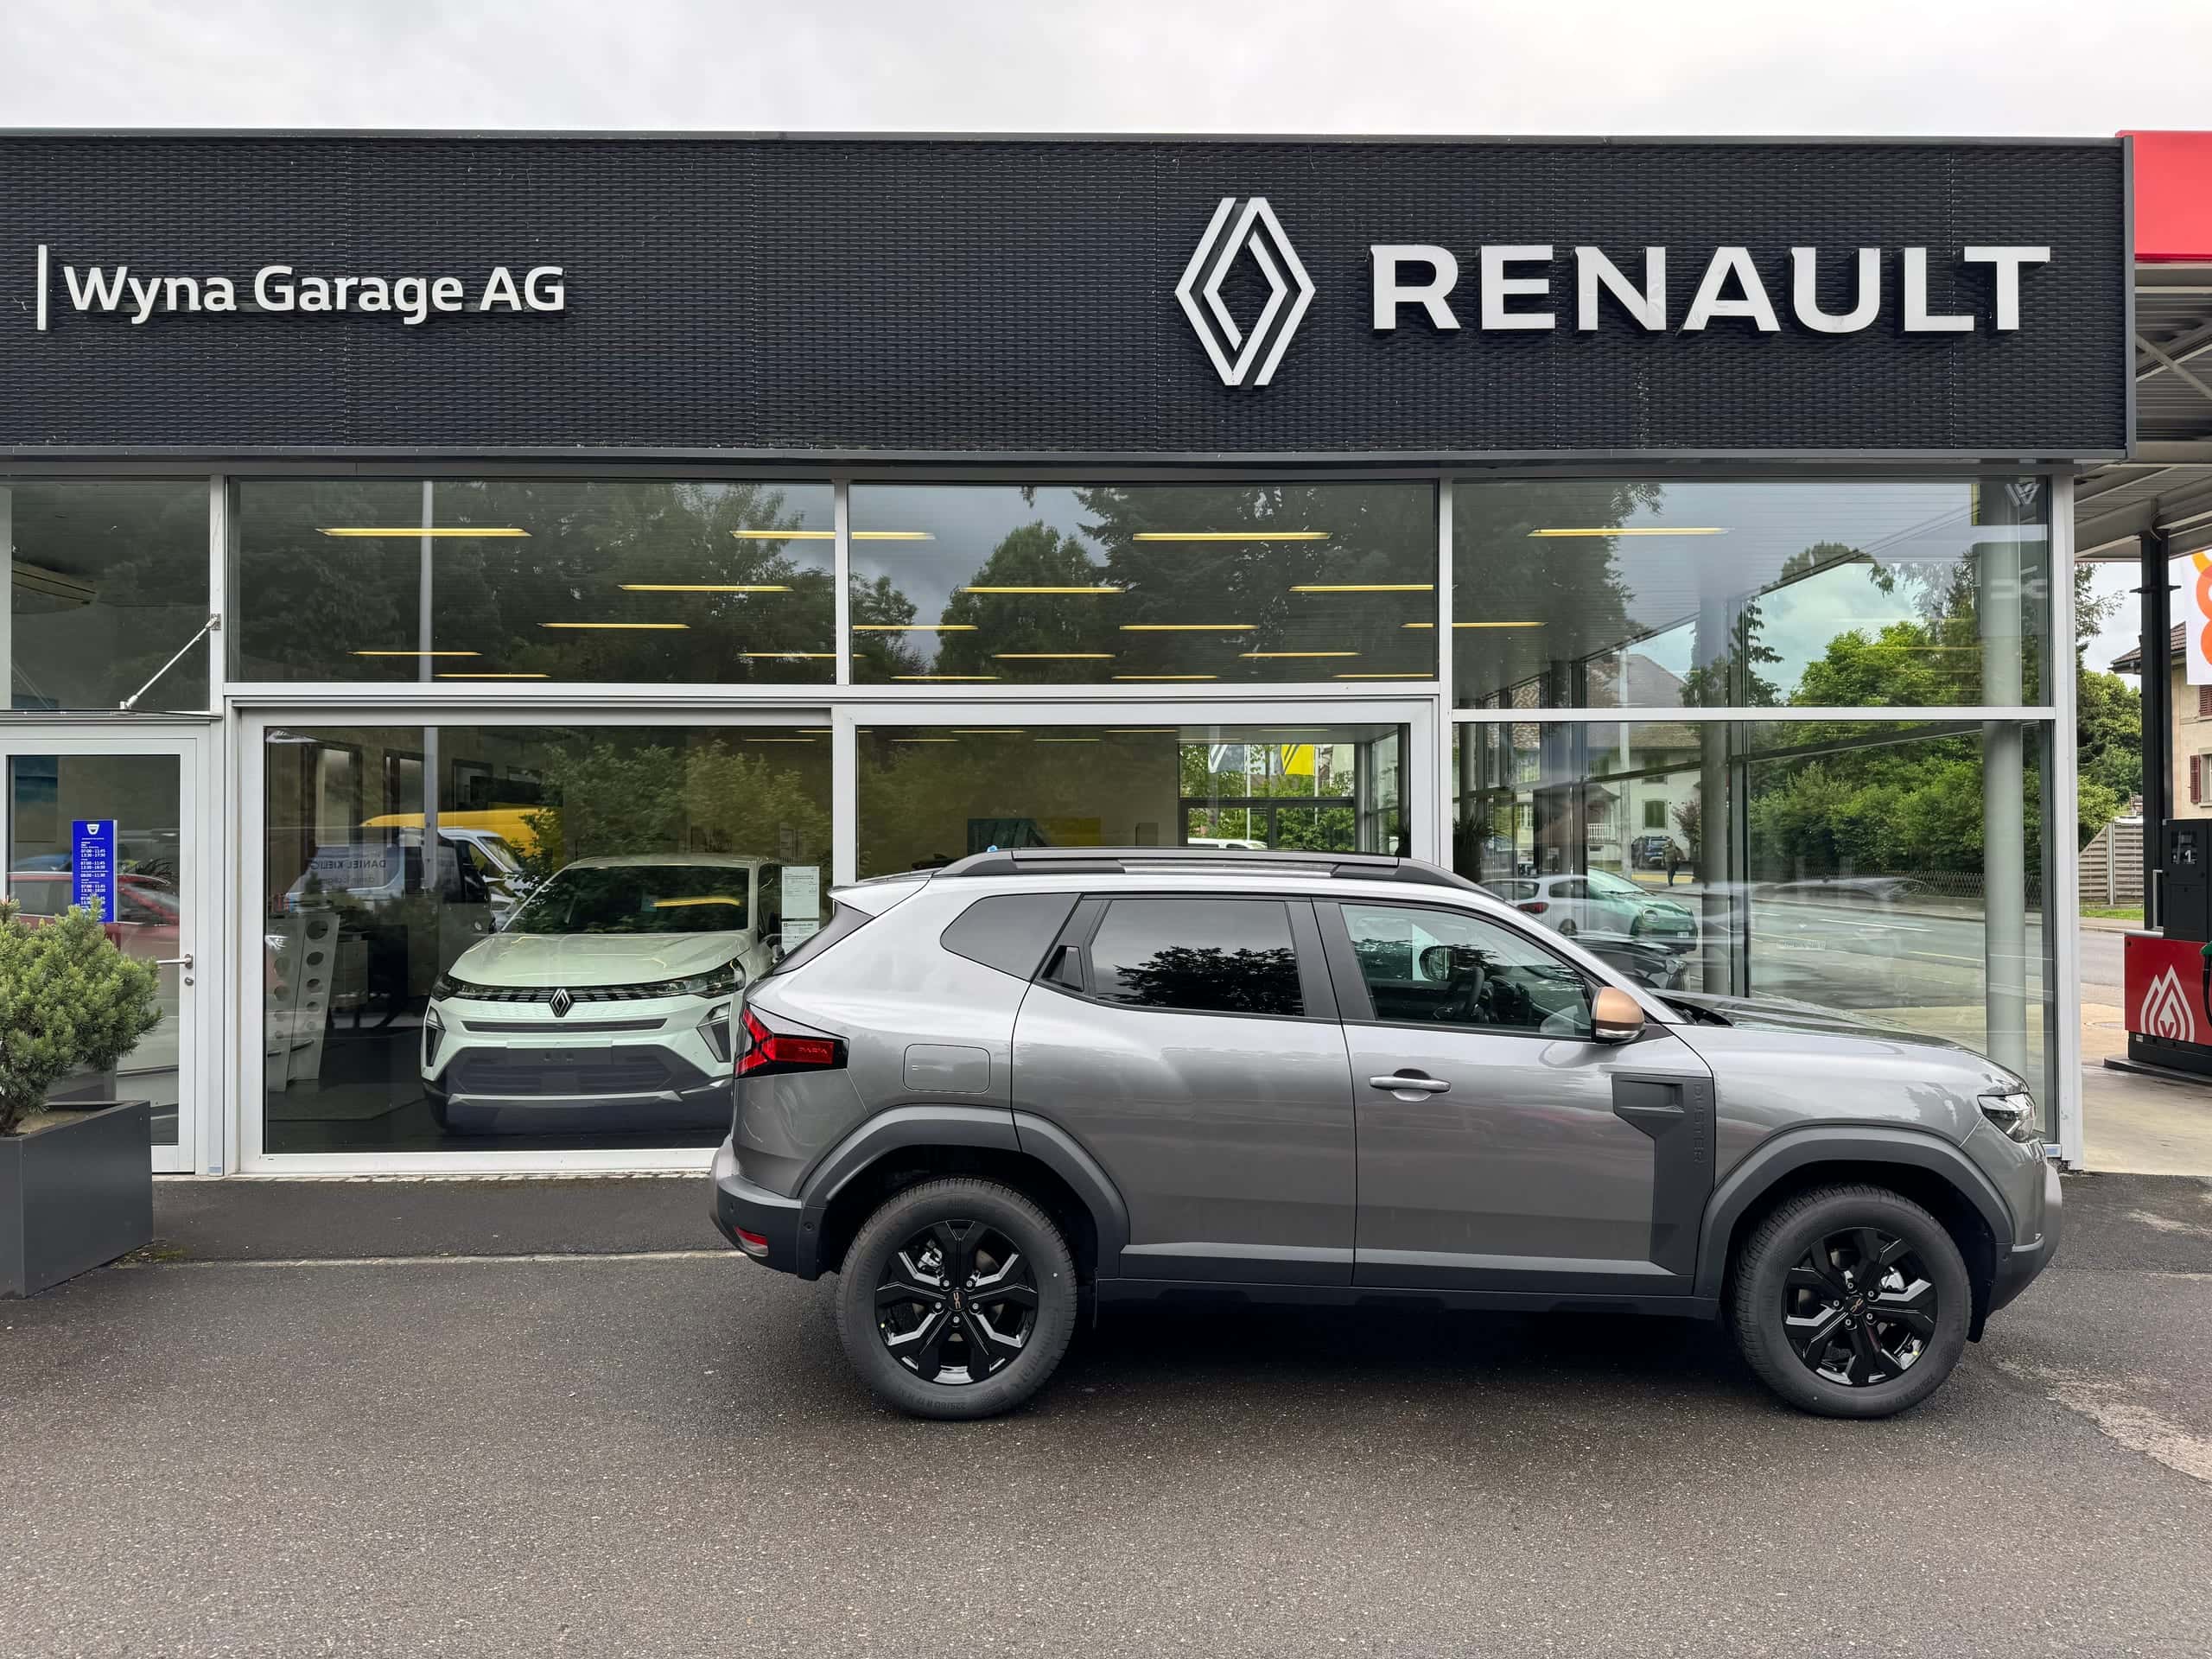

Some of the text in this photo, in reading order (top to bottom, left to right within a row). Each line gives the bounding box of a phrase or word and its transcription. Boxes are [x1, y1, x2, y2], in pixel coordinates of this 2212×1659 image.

[63, 264, 566, 325] Wyna Garage AG
[1370, 244, 2051, 334] RENAULT
[2184, 849, 2191, 863] 1
[1693, 1084, 1705, 1166] DUSTER
